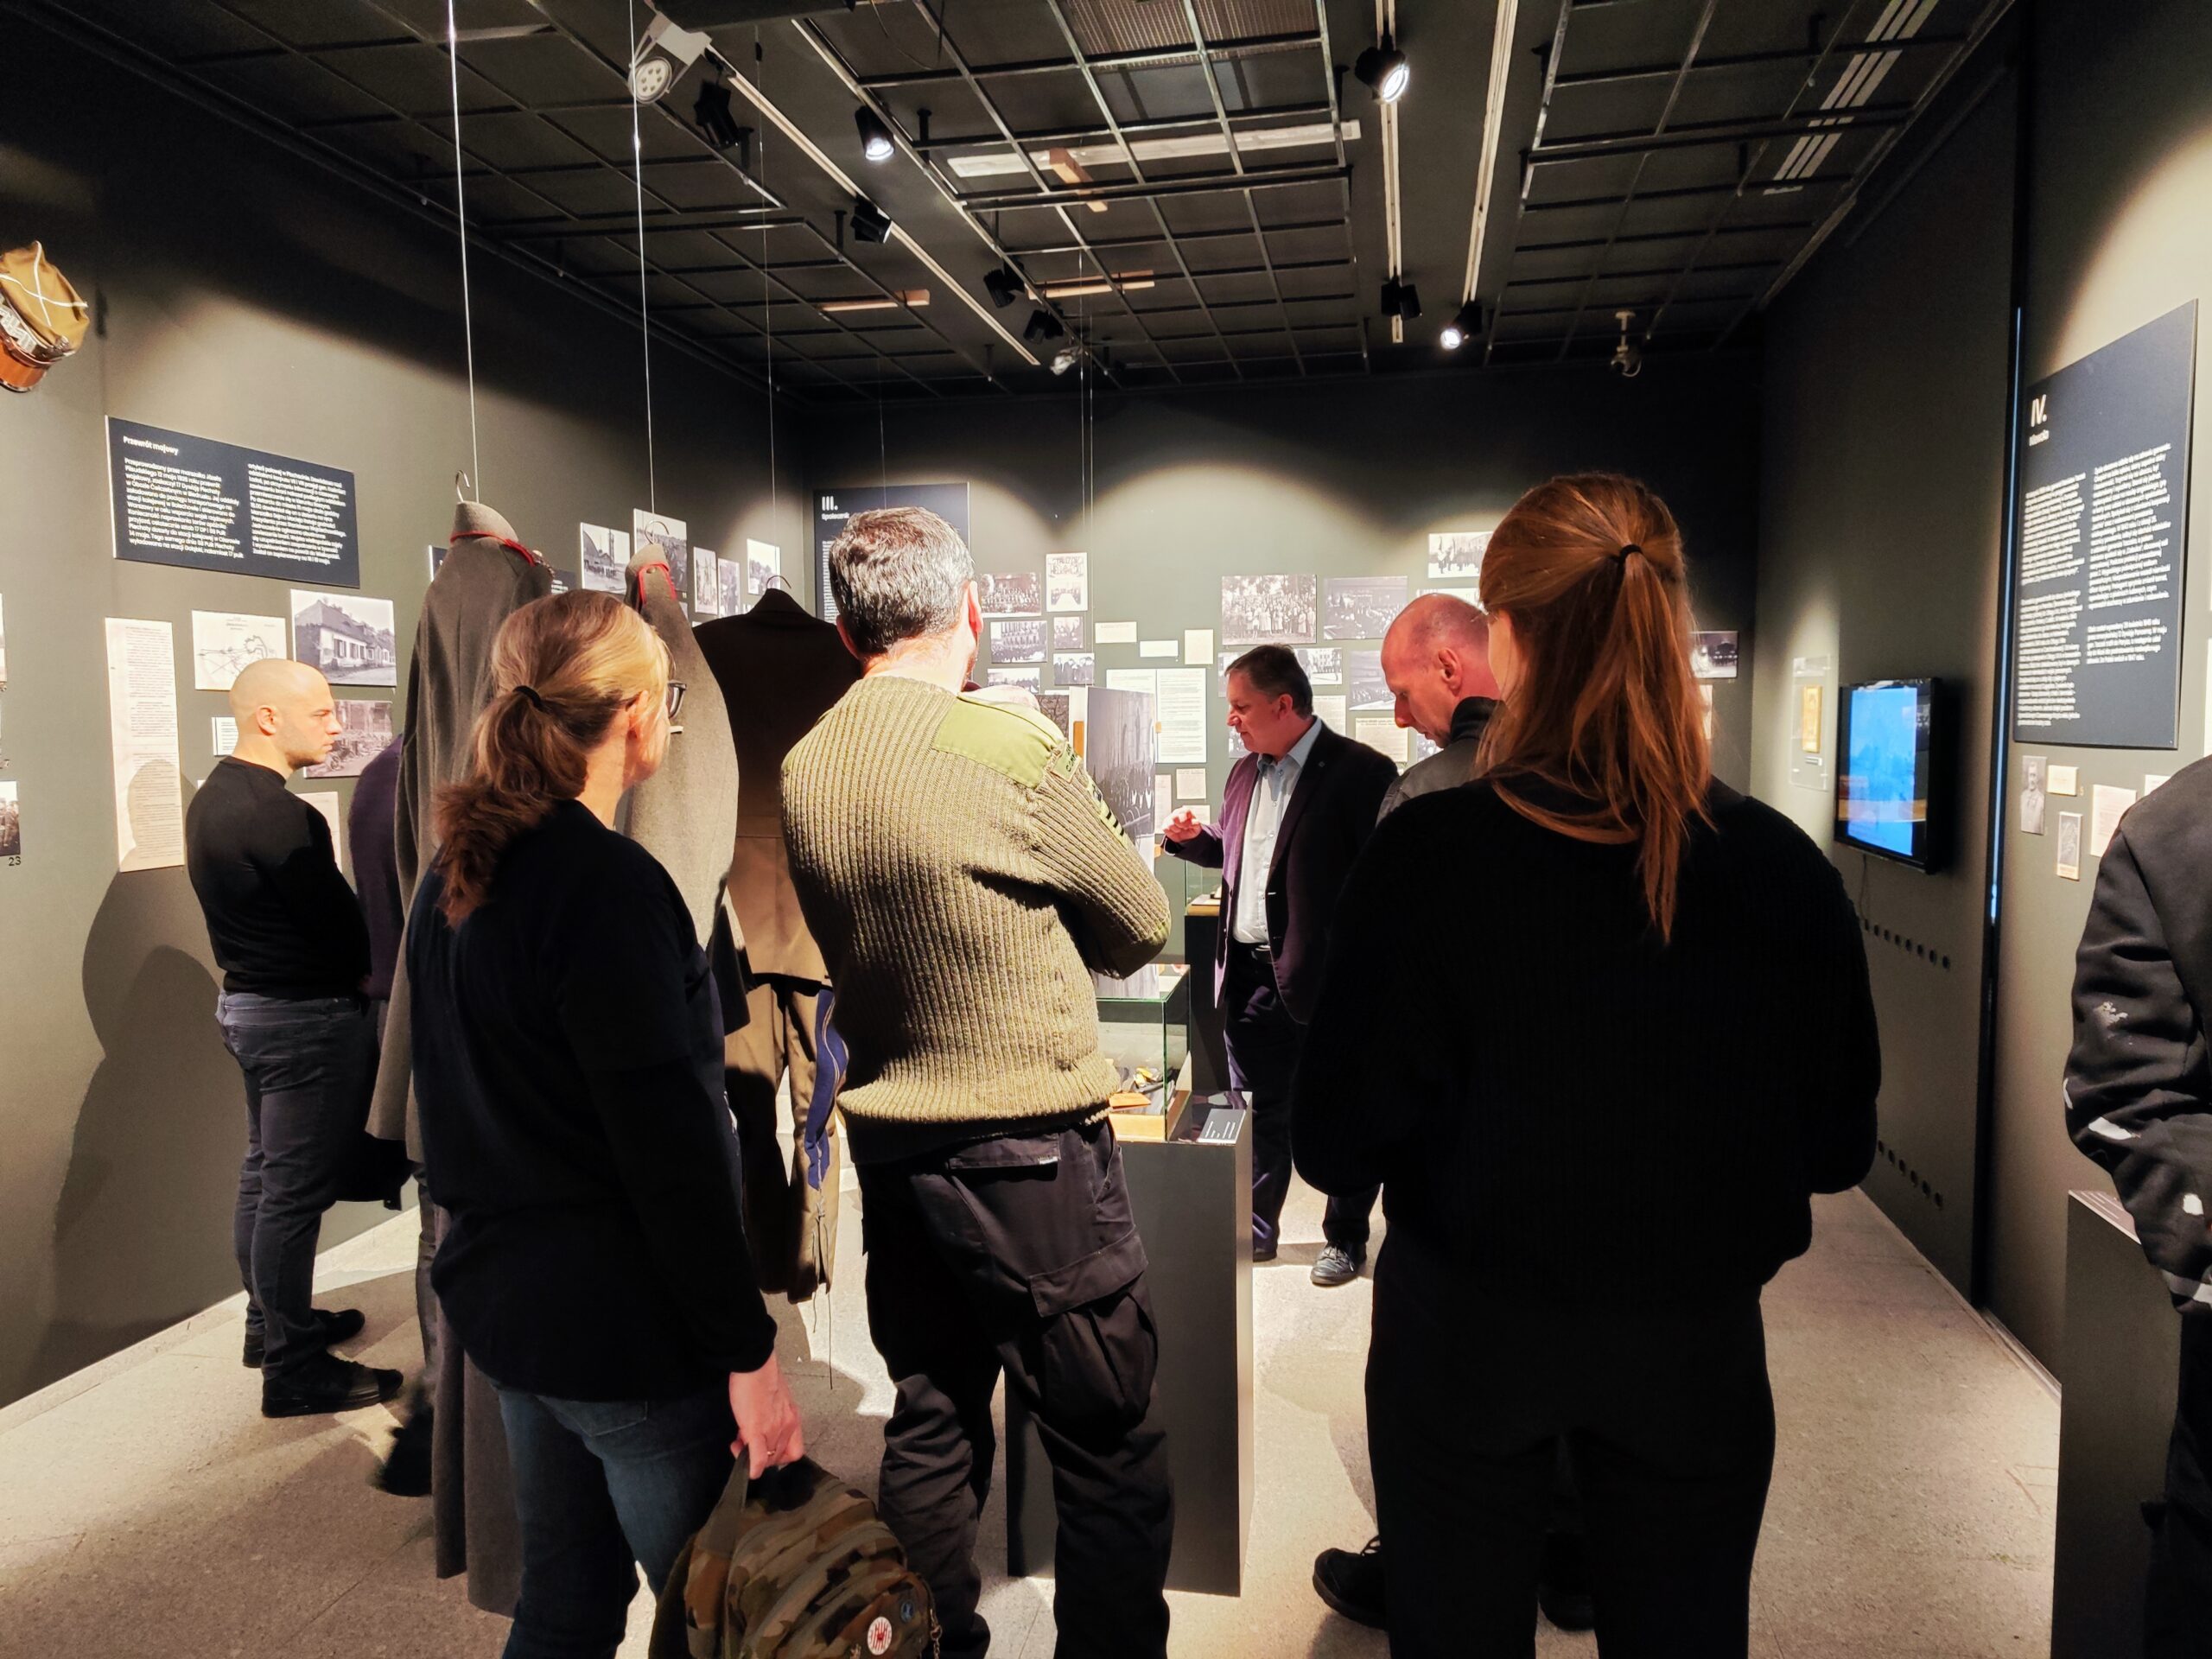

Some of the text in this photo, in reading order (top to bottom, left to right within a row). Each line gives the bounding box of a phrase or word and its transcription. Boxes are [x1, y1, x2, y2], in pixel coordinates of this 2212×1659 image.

[2031, 394, 2048, 427] IV.
[822, 496, 838, 511] III.
[8, 855, 22, 867] 23
